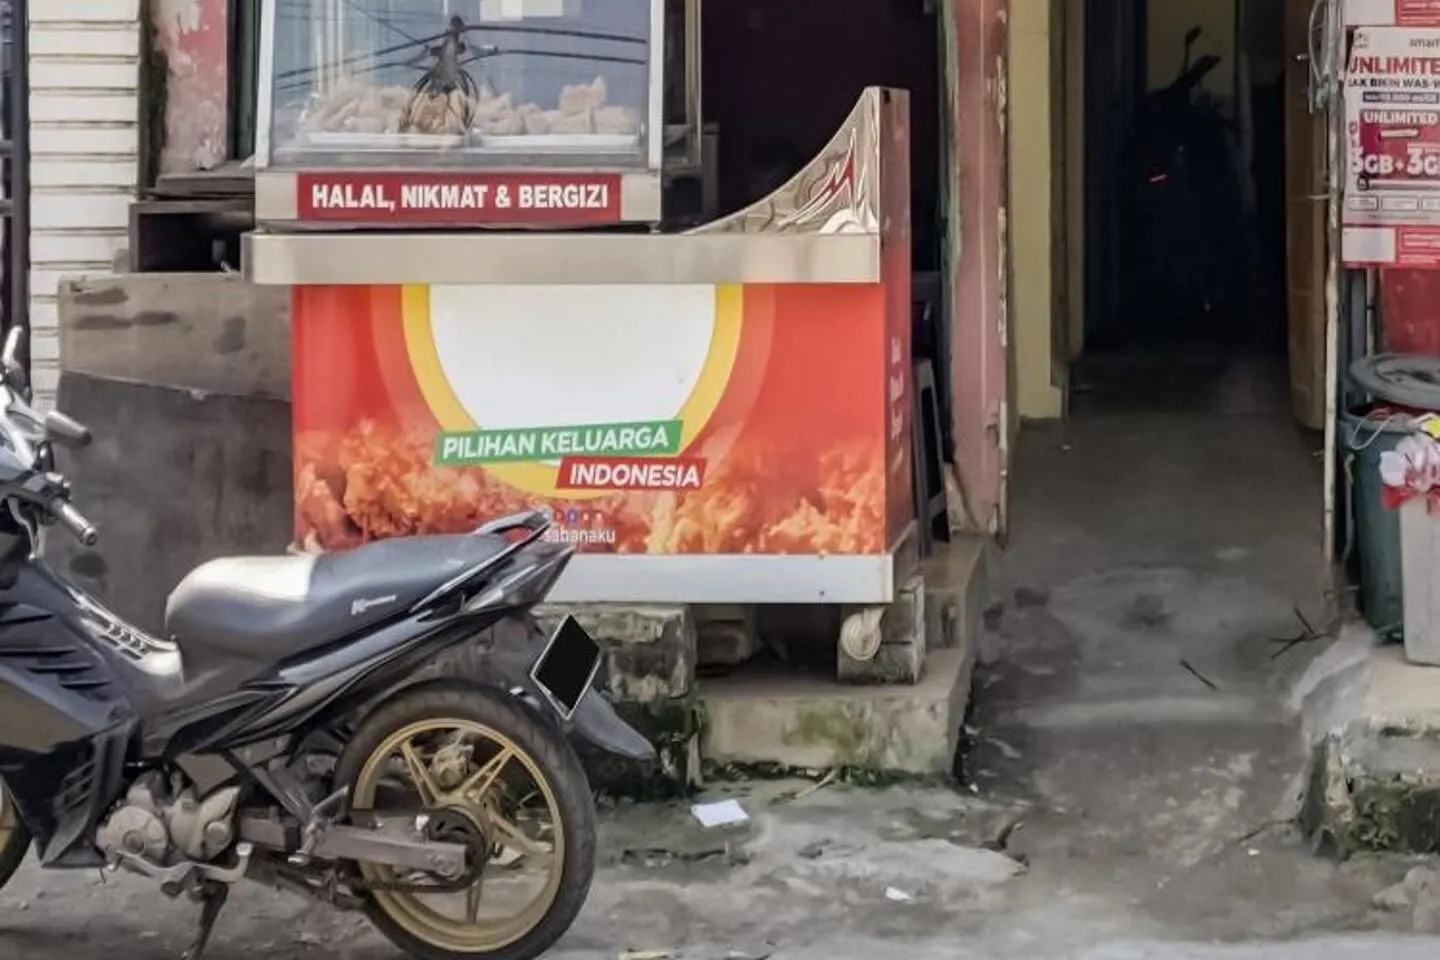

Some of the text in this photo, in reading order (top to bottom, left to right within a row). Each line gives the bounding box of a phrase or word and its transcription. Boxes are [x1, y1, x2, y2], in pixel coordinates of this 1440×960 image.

[1363, 111, 1438, 125] UNLIMITED
[311, 184, 608, 212] HALAL, NIKMAT & BERGIZI
[443, 426, 670, 460] PILIHAN KELUARGA
[569, 463, 700, 487] INDONESIA
